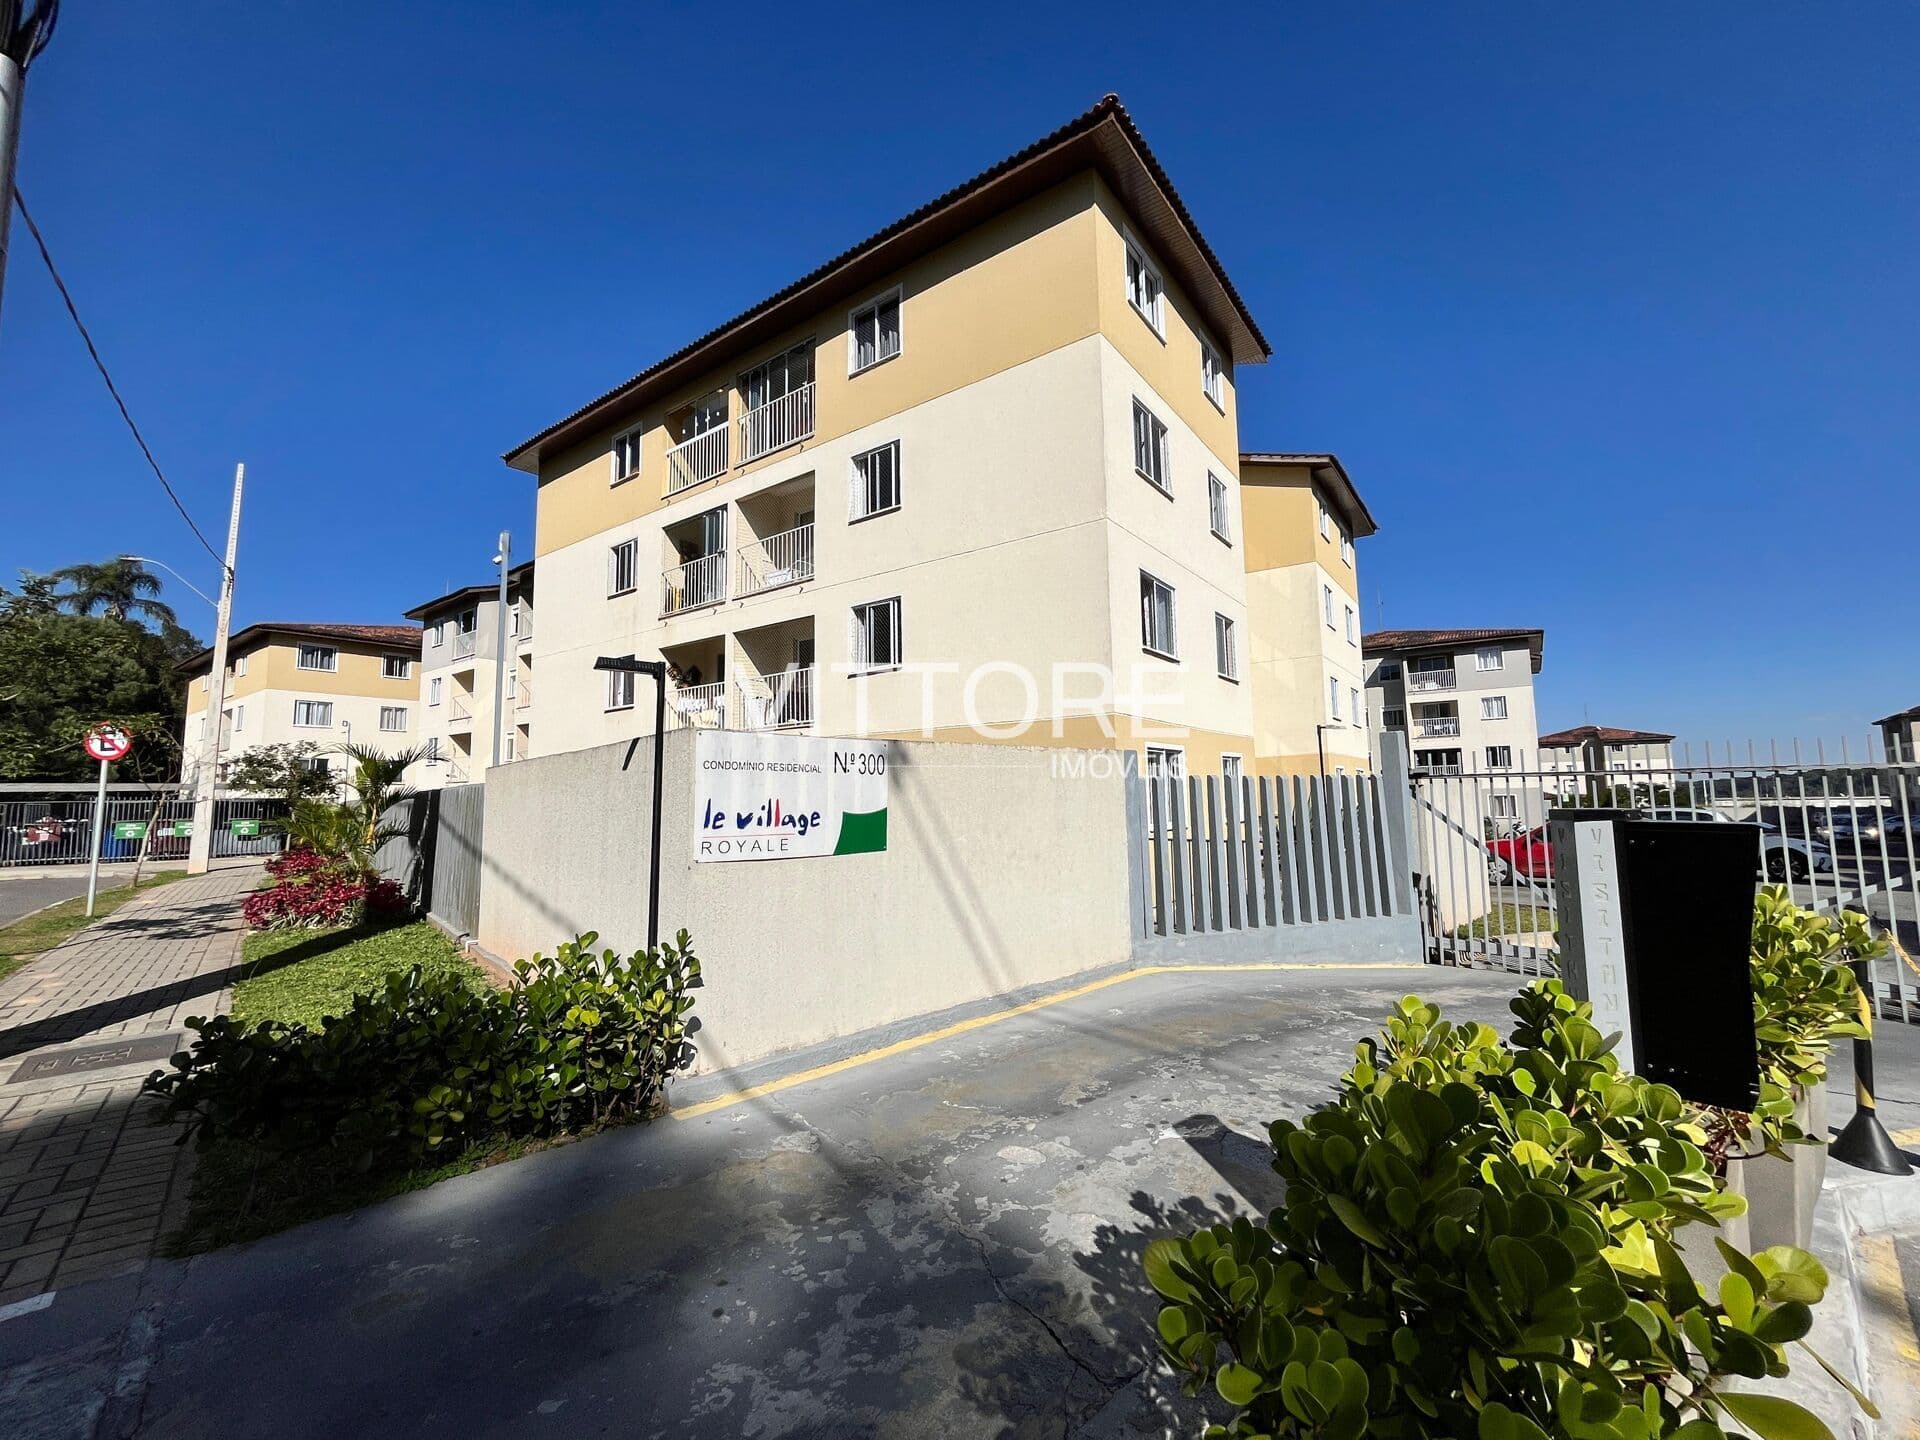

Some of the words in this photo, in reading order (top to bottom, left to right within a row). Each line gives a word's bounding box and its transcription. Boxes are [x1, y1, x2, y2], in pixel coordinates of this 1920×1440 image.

[703, 759, 764, 771] CONDOMÍNIO
[767, 763, 822, 773] RESIDENCIAL
[859, 753, 885, 775] 300
[703, 798, 726, 830] le
[736, 798, 821, 836] village
[701, 838, 790, 855] ROYALE
